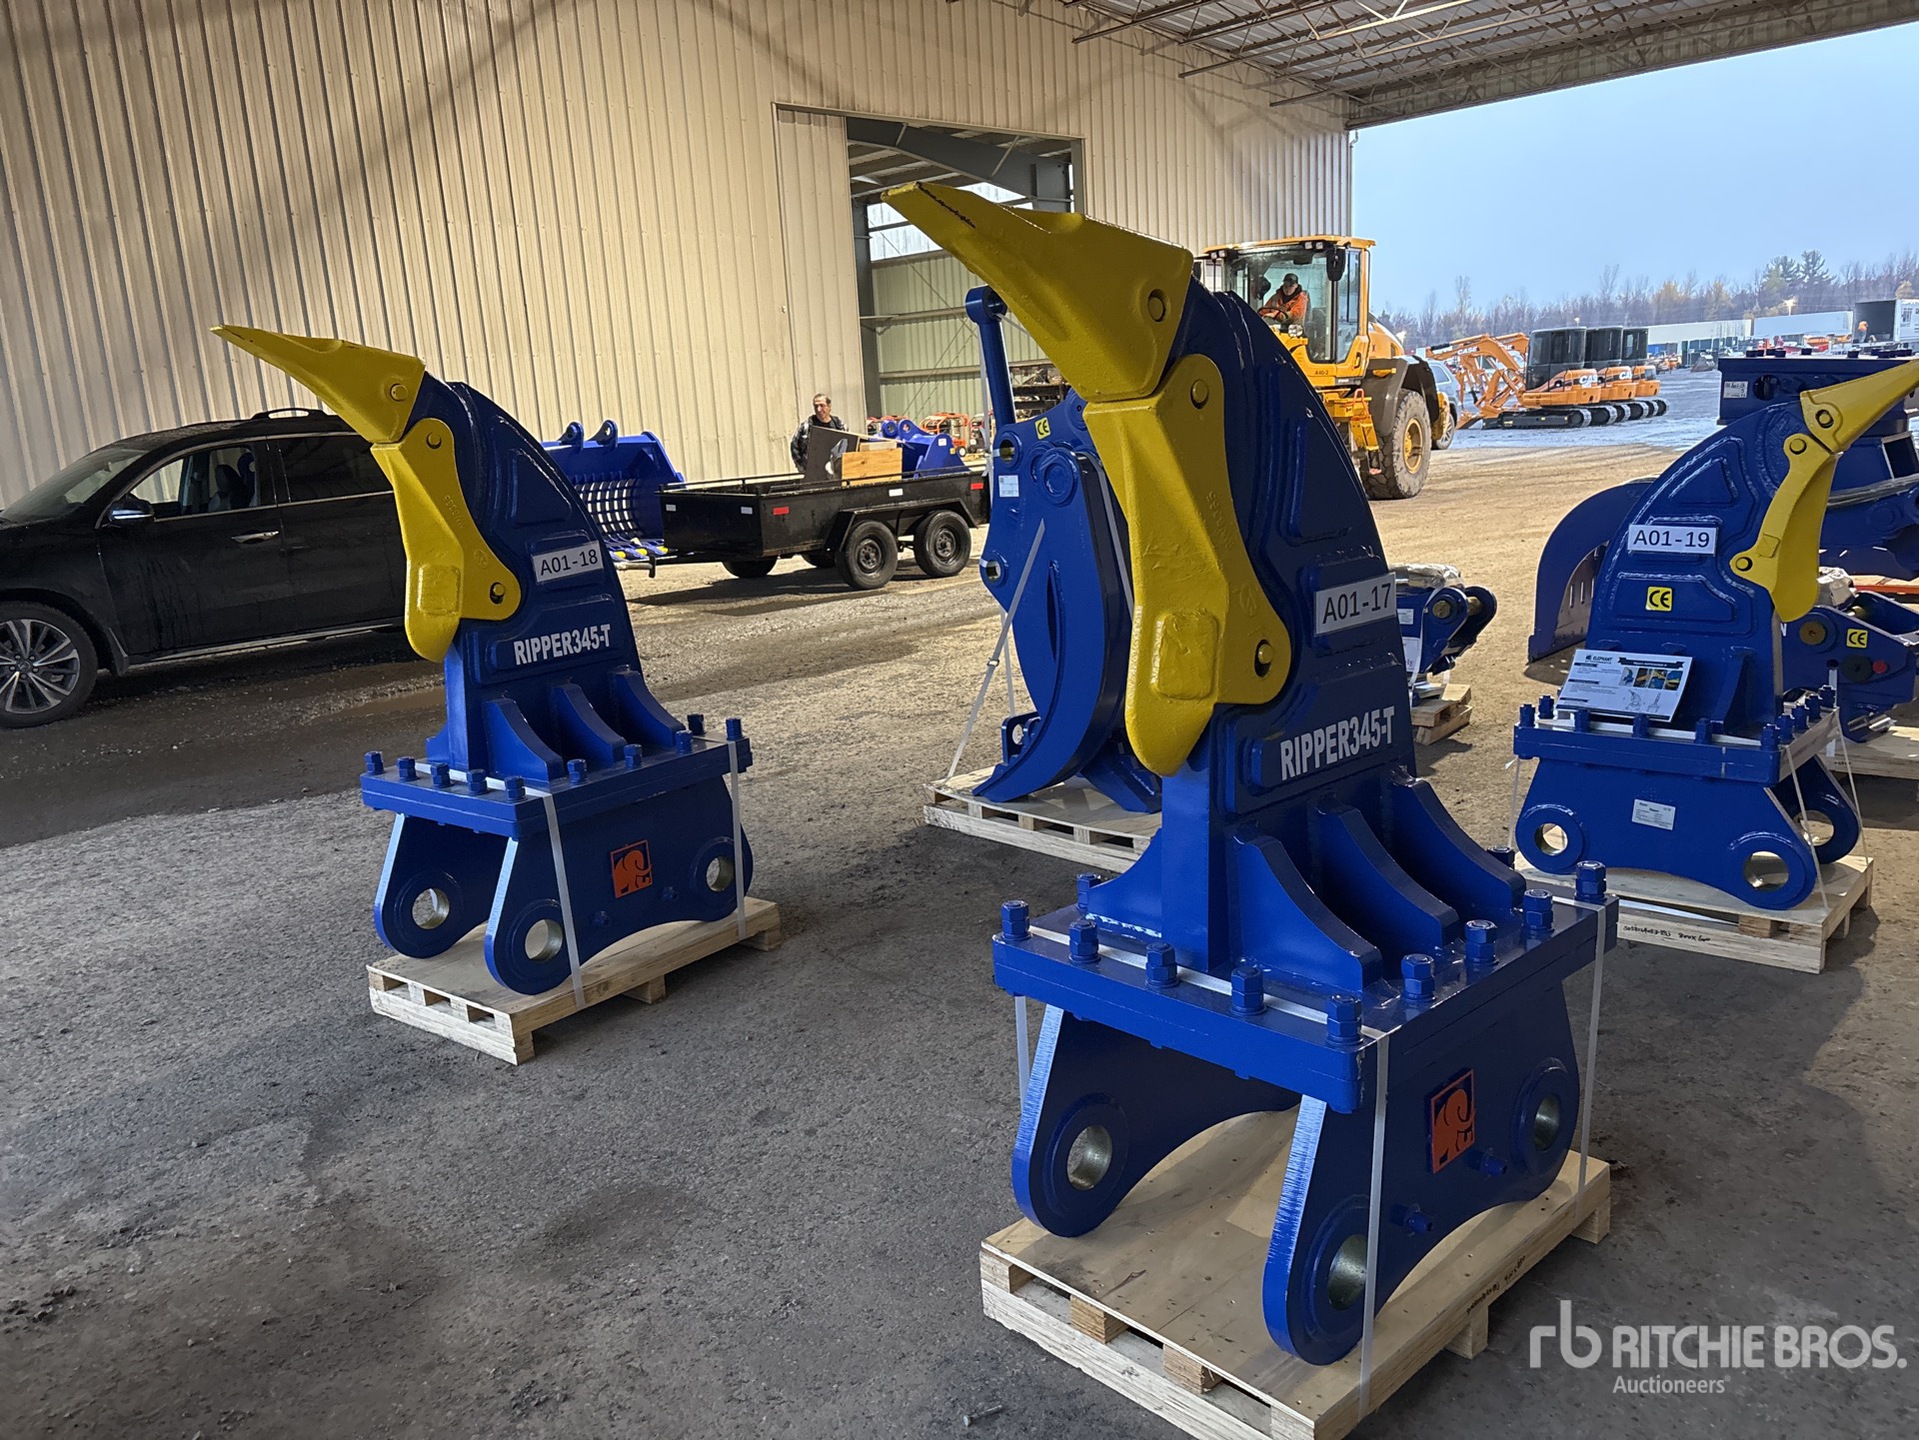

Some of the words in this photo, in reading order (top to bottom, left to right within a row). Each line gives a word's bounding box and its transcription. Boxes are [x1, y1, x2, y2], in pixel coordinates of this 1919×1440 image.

[1633, 529, 1710, 548] A01-19
[540, 549, 598, 576] A01-18
[1322, 582, 1391, 624] A01-17
[1649, 590, 1671, 608] CE
[513, 624, 611, 666] RIPPER345-T
[1848, 631, 1867, 646] CE
[1280, 705, 1395, 781] RIPPER345-T
